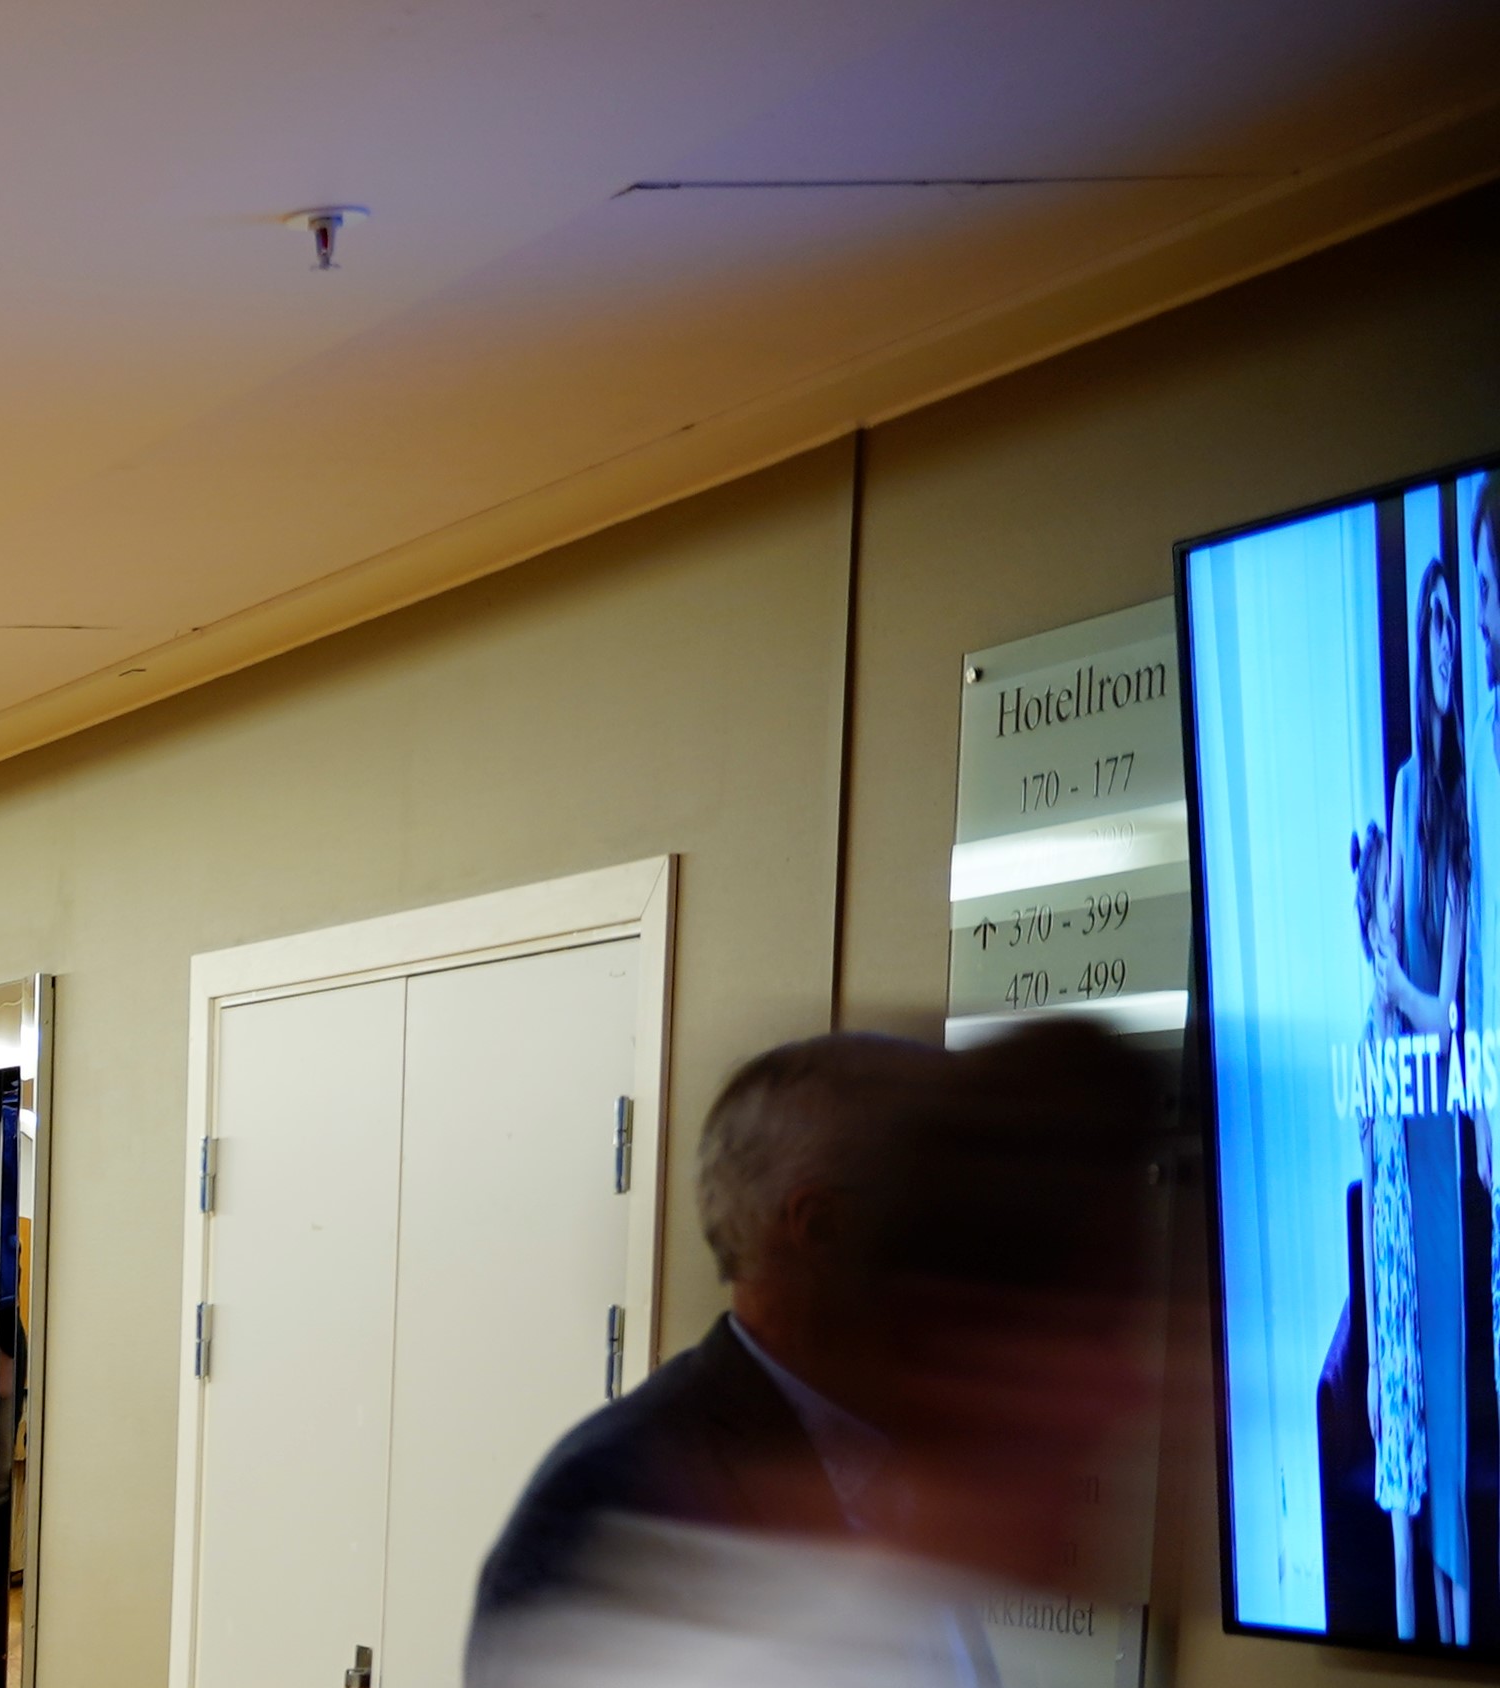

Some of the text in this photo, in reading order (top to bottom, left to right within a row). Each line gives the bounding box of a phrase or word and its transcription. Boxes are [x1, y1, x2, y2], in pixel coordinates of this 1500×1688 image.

[996, 662, 1166, 738] Hotellrom
[1020, 769, 1060, 814] 170
[1093, 751, 1135, 798] 177
[1009, 904, 1052, 947] 370
[1082, 890, 1131, 936] 399
[1005, 970, 1049, 1010] 470
[1077, 958, 1126, 1000] 499
[1331, 1000, 1500, 1119] UANSETT ÅRS
[983, 1593, 1095, 1637] kklandet
